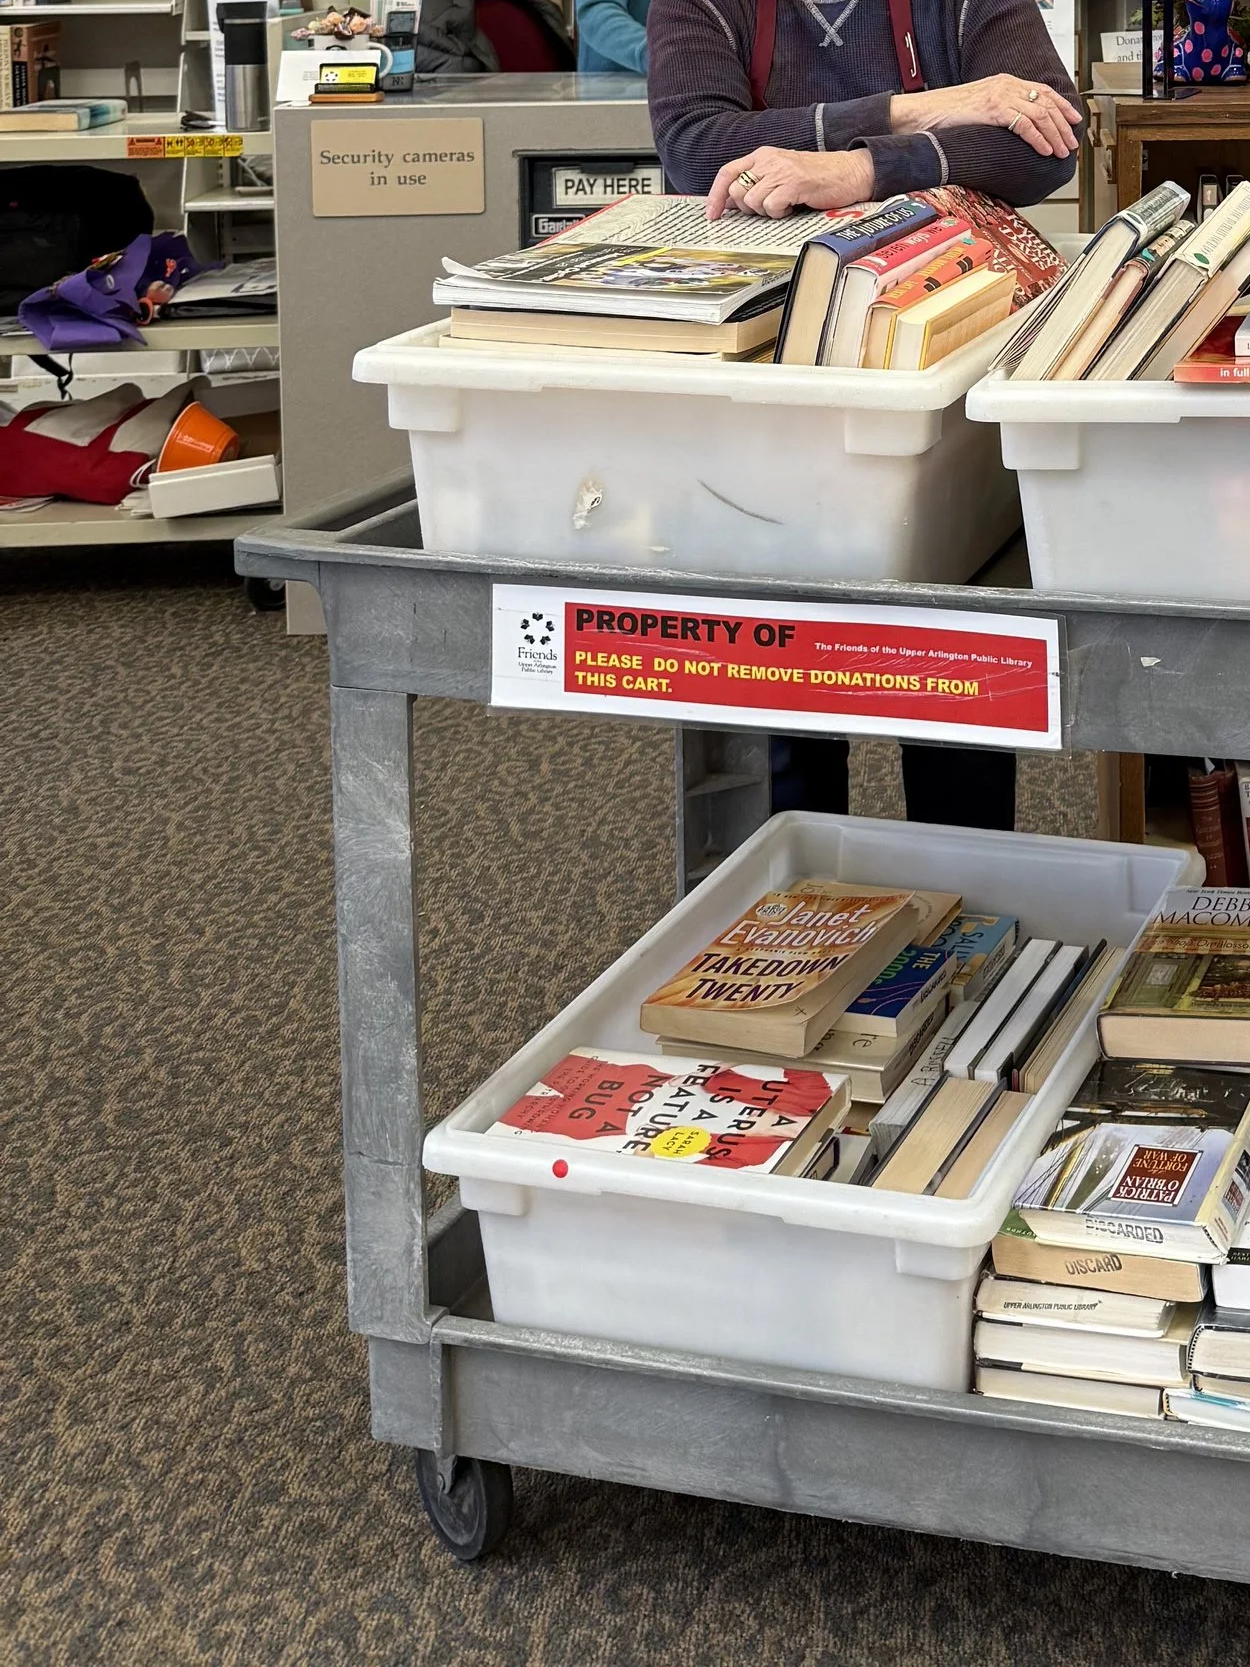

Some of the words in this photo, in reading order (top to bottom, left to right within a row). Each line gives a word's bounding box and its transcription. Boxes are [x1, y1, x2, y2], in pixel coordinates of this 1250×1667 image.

[320, 150, 394, 168] Security
[402, 150, 475, 164] cameras
[370, 171, 388, 185] in
[397, 174, 427, 185] use
[564, 178, 597, 196] PAY
[603, 177, 653, 195] HERE
[1220, 368, 1230, 378] in
[1233, 367, 1250, 378] full
[576, 608, 742, 645] PROPERTY
[753, 622, 796, 649] OF
[815, 642, 832, 651] The
[834, 643, 868, 653] Friends
[870, 645, 880, 653] of
[881, 646, 897, 655] the
[899, 647, 926, 658] Upper
[928, 649, 969, 662] Arlington
[971, 653, 998, 664] Public
[1001, 656, 1032, 668] Library
[518, 647, 558, 661] Friends
[574, 671, 617, 687] THIS
[622, 675, 673, 693] CART.
[575, 650, 643, 670] PLEASE
[654, 657, 678, 672] DO
[684, 660, 721, 676] NOT
[727, 663, 804, 683] REMOVE
[810, 669, 921, 691] DONATIONS
[926, 677, 979, 696] FROM
[774, 900, 874, 928] Janet
[720, 919, 878, 948] Evanovich
[691, 953, 850, 977] TAKEDOWN
[686, 978, 804, 1002] TWENTY
[568, 1080, 625, 1121] BUG
[623, 1074, 662, 1118] NOT
[705, 1080, 785, 1160] UTERUS
[662, 1132, 685, 1152] LACY
[672, 1130, 700, 1155] SARAH
[1133, 1158, 1188, 1171] FORTUNE
[1143, 1150, 1168, 1162] WAR
[1122, 1176, 1180, 1191] O'BRIAN
[1116, 1187, 1176, 1203] PATRICK
[1065, 1254, 1123, 1276] DISCARD
[1003, 1302, 1021, 1310] UPPER
[1022, 1302, 1053, 1310] ARLINGTON
[1074, 1302, 1099, 1311] LIBRARY
